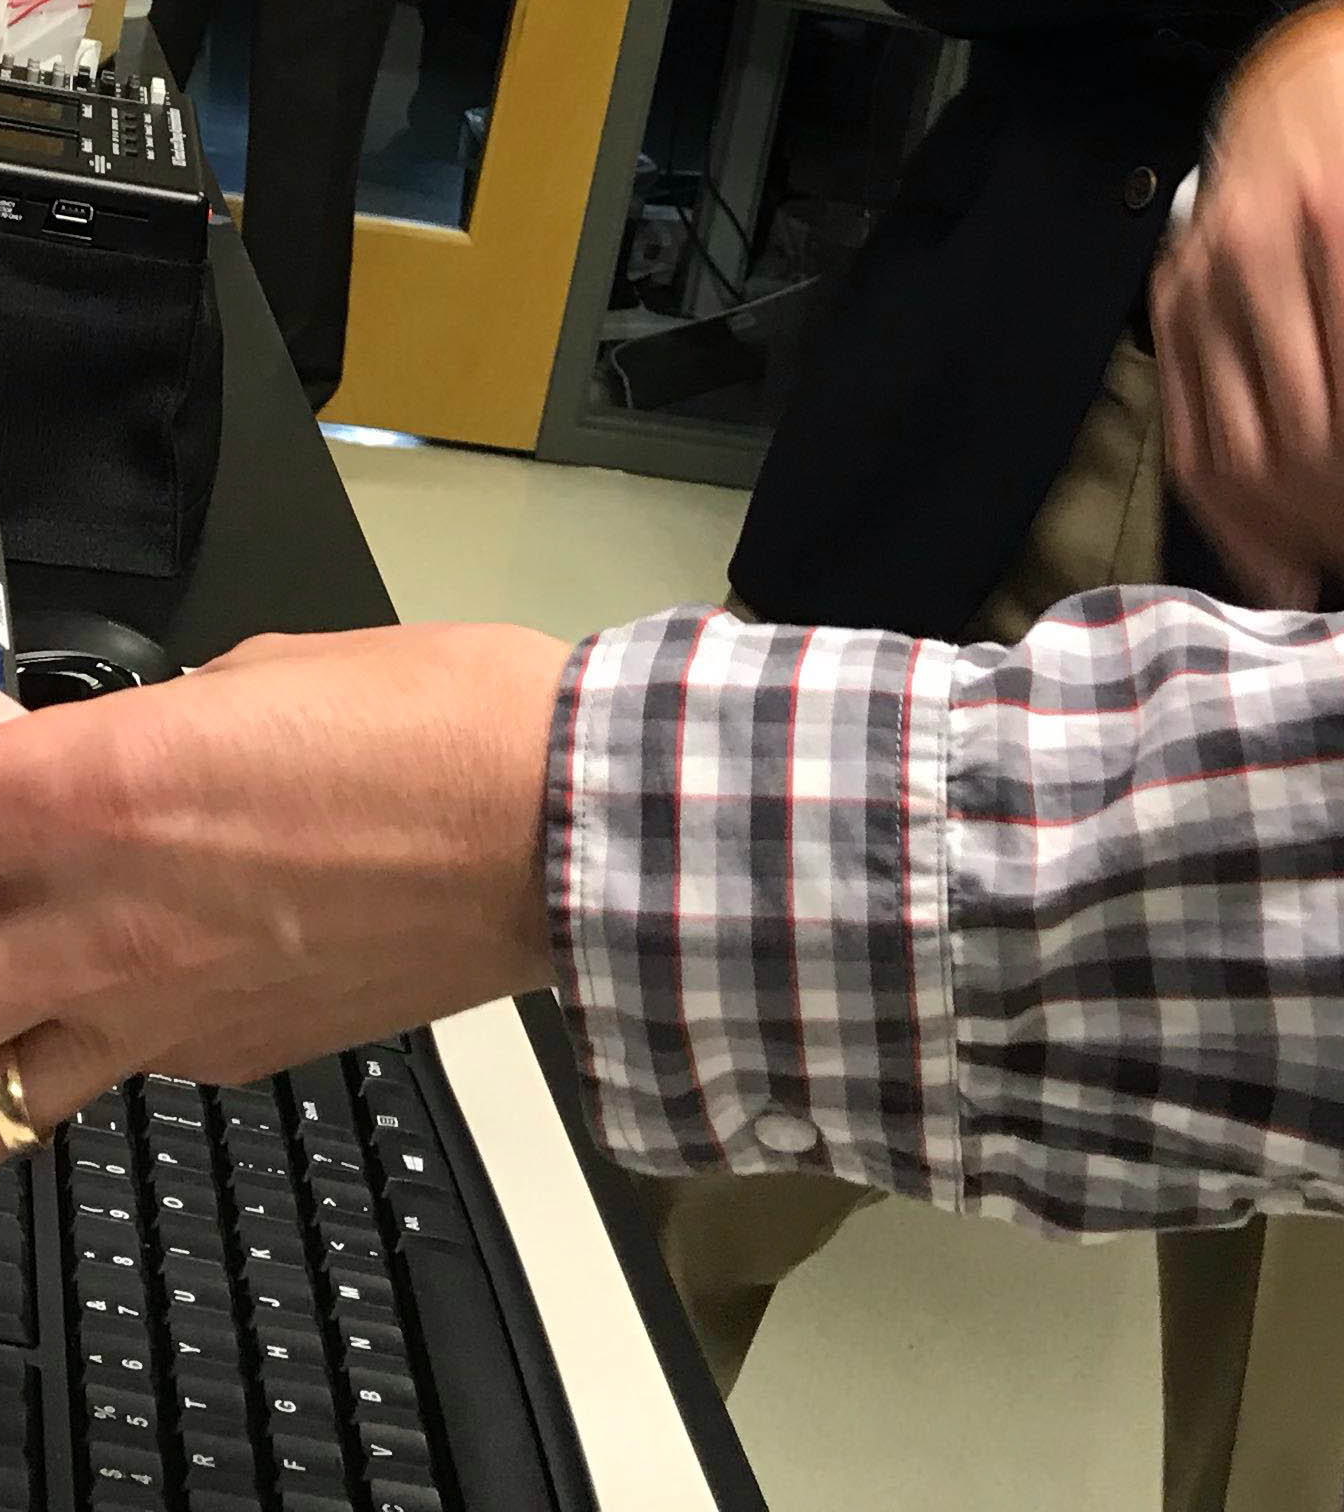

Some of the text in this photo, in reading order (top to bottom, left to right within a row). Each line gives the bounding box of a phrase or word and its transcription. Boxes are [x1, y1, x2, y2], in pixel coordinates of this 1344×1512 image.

[158, 1153, 177, 1163] P
[110, 1210, 129, 1219] 9
[250, 1248, 271, 1259] K
[113, 1256, 133, 1266] 8
[174, 1290, 195, 1302] U
[339, 1286, 360, 1299] M
[259, 1297, 280, 1307] J
[118, 1306, 138, 1315] 7
[179, 1343, 200, 1352] Y
[350, 1337, 371, 1349] N
[267, 1346, 288, 1358] H
[122, 1359, 143, 1369] 6
[360, 1390, 381, 1402] B
[185, 1397, 206, 1408] T
[275, 1400, 296, 1412] G
[127, 1415, 148, 1427] 5
[371, 1444, 392, 1455] V
[193, 1454, 215, 1467] R
[284, 1459, 305, 1470] F
[131, 1474, 152, 1484] 4
